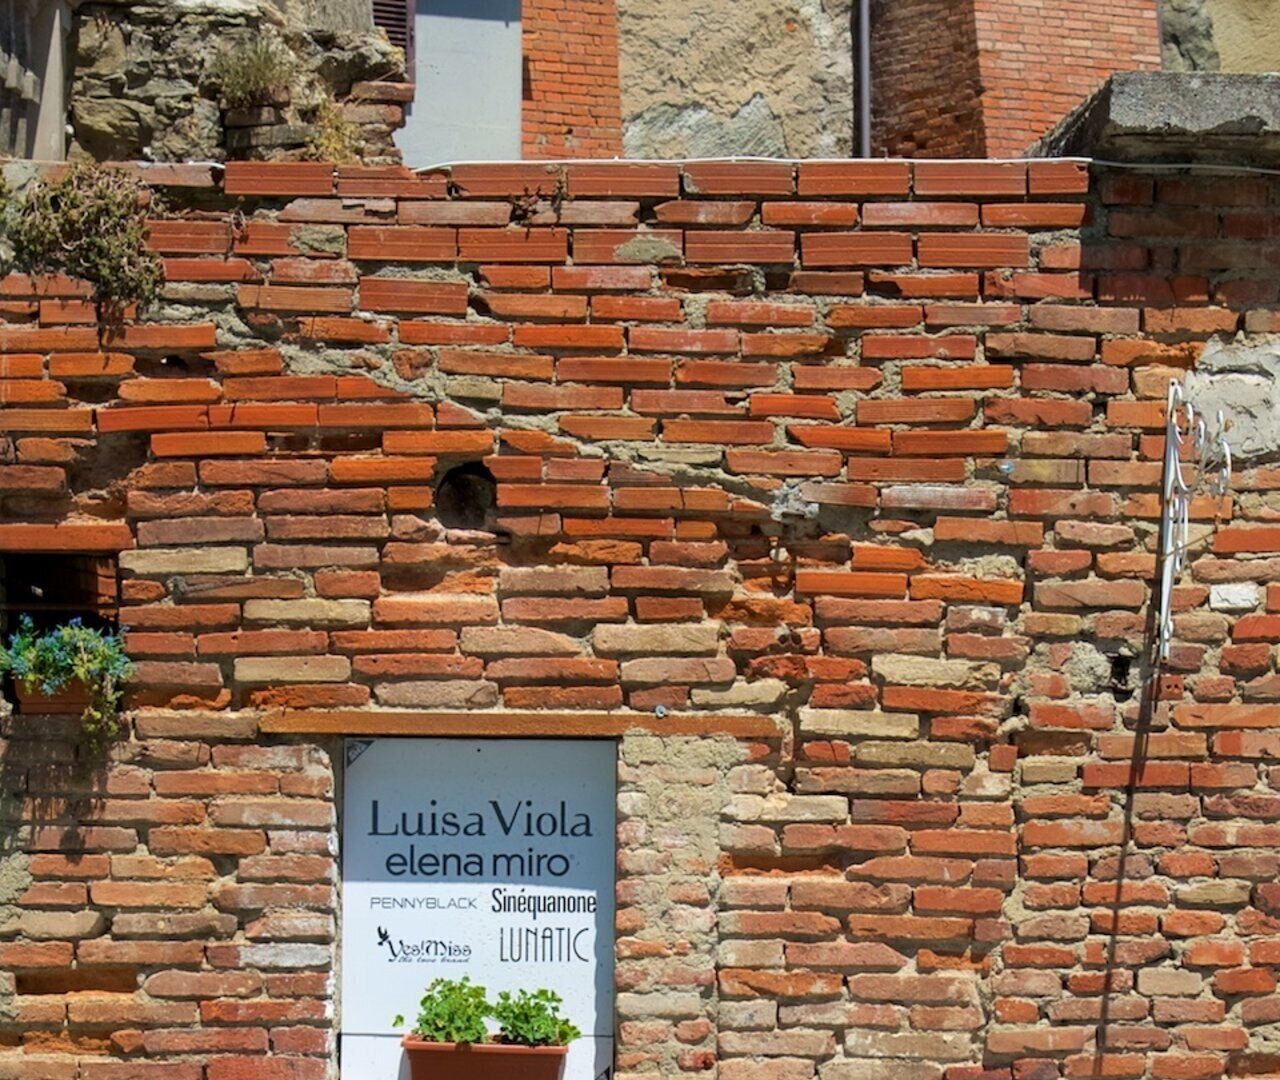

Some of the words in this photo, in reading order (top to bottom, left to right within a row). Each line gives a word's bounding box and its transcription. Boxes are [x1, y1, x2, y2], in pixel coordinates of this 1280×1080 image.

[367, 799, 486, 837] Luisa
[487, 799, 593, 837] Viola
[385, 845, 484, 877] elena
[491, 848, 570, 877] miro
[370, 896, 478, 910] PENNYBLACK
[490, 887, 596, 920] Sinéquanone
[499, 928, 590, 963] LUNATIC
